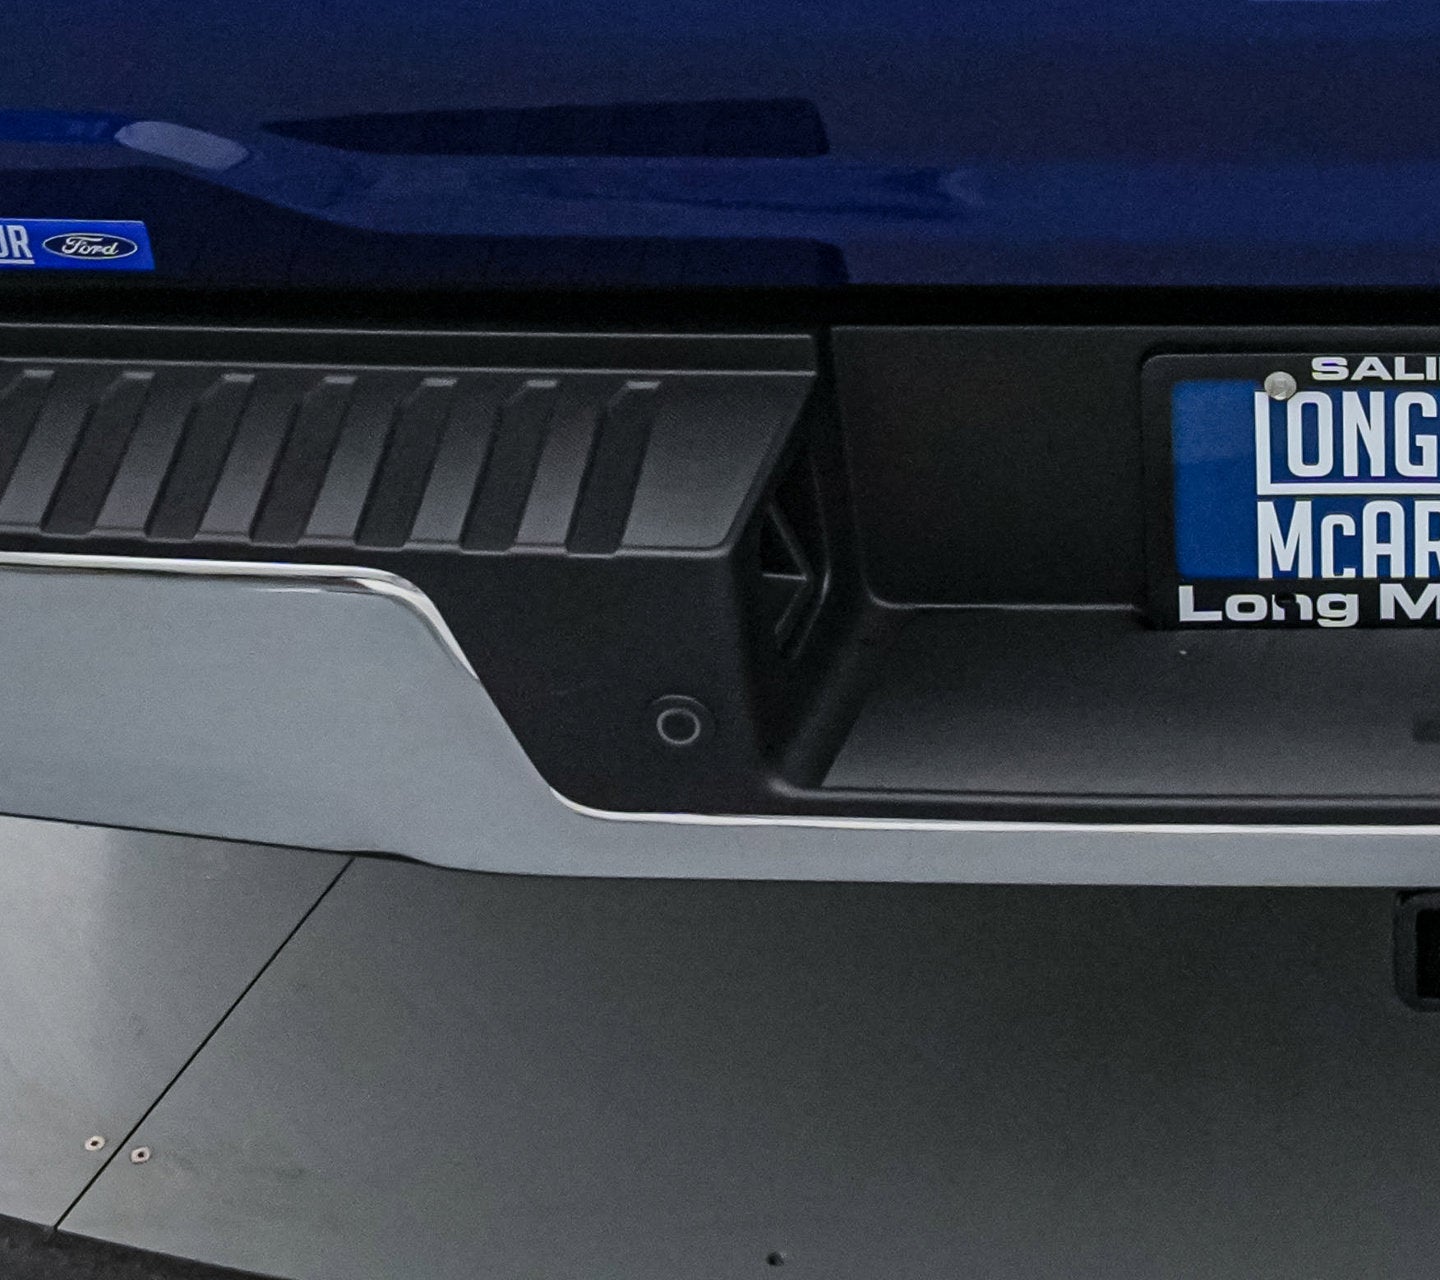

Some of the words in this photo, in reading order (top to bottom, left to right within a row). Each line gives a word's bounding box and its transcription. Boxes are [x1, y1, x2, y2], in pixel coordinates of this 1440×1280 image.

[62, 235, 120, 256] Ford
[1256, 390, 1438, 496] LONG
[1178, 584, 1360, 627] Long
